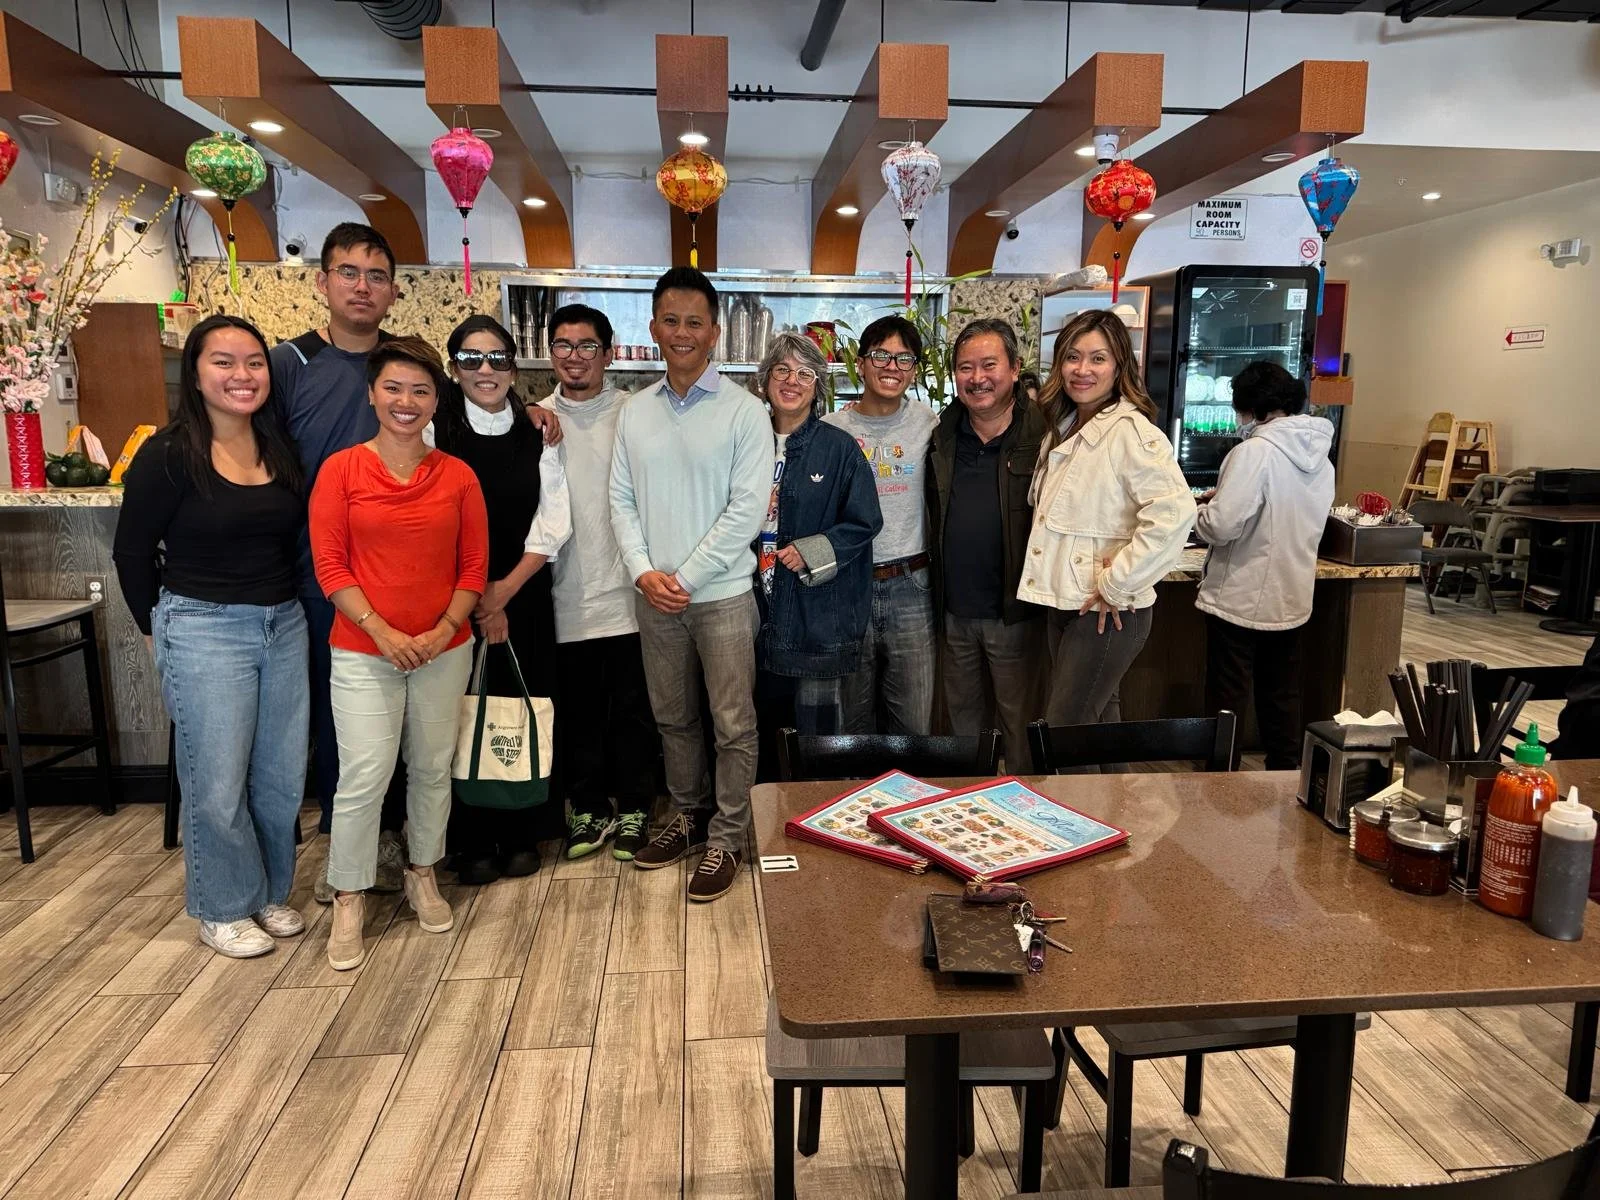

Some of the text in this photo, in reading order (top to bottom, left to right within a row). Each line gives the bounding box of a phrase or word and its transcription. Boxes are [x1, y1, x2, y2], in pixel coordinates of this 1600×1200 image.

[1198, 201, 1242, 209] MAXIMUM
[1206, 210, 1232, 218] ROOM
[1196, 220, 1241, 229] CAPACITY
[763, 857, 798, 871] 11
